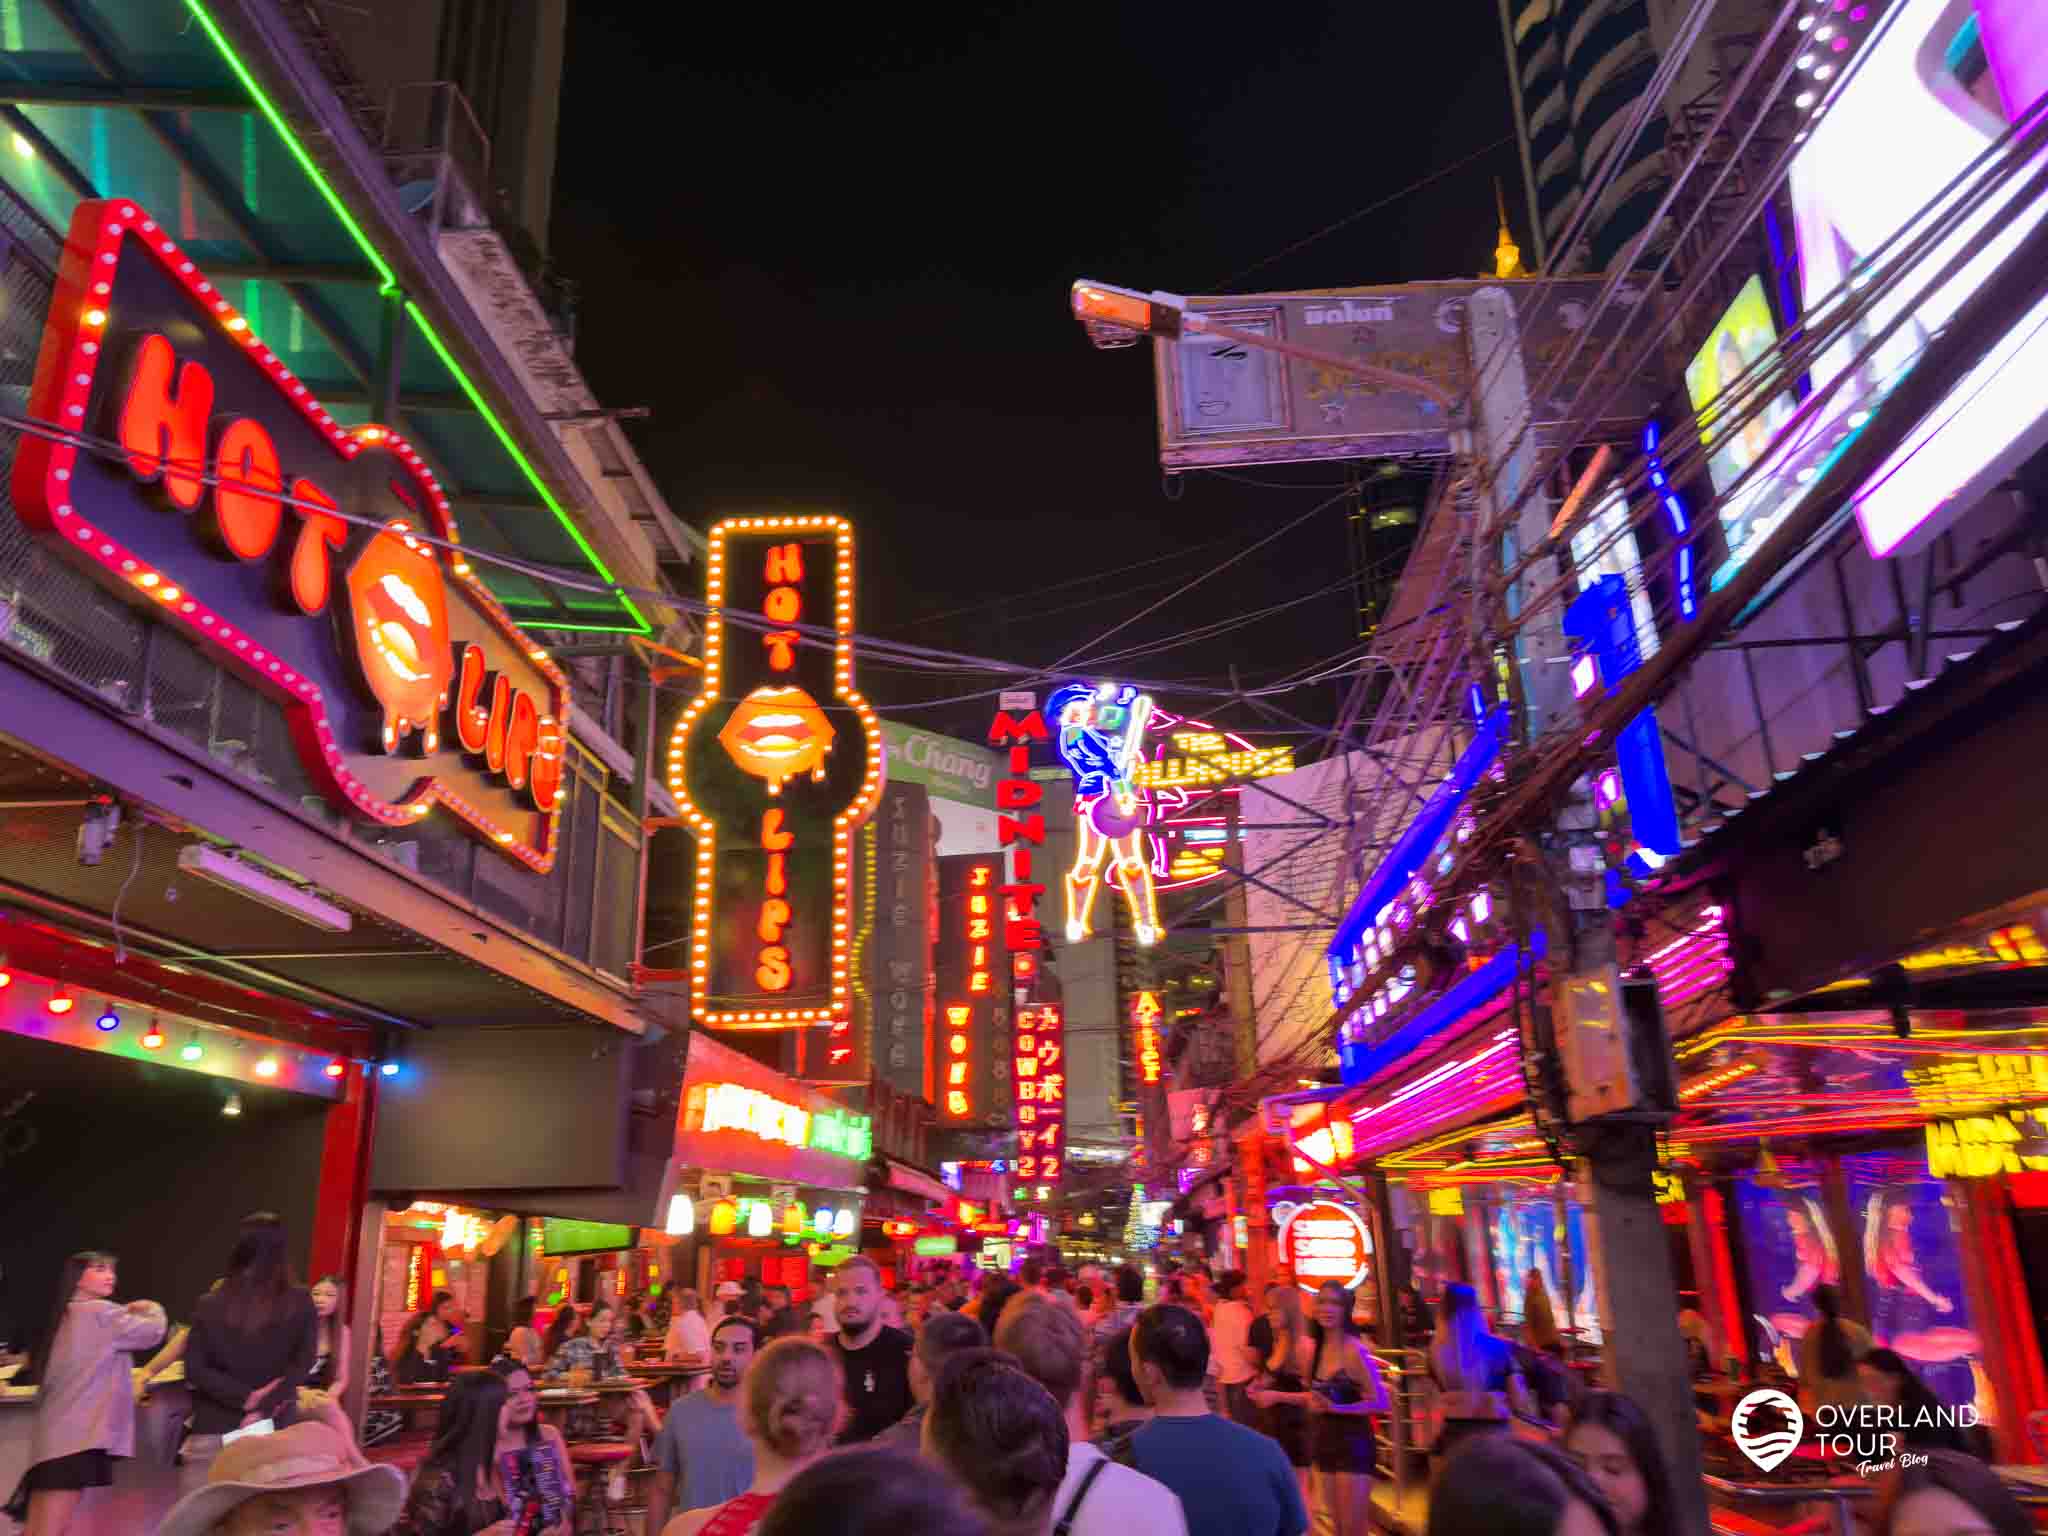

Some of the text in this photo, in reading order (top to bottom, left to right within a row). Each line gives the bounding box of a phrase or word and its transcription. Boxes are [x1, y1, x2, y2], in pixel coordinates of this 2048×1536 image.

[120, 333, 561, 814] HOT LIPS
[755, 543, 804, 992] HOT LIPS
[904, 734, 993, 790] Chang
[988, 710, 1049, 950] MIDNITE
